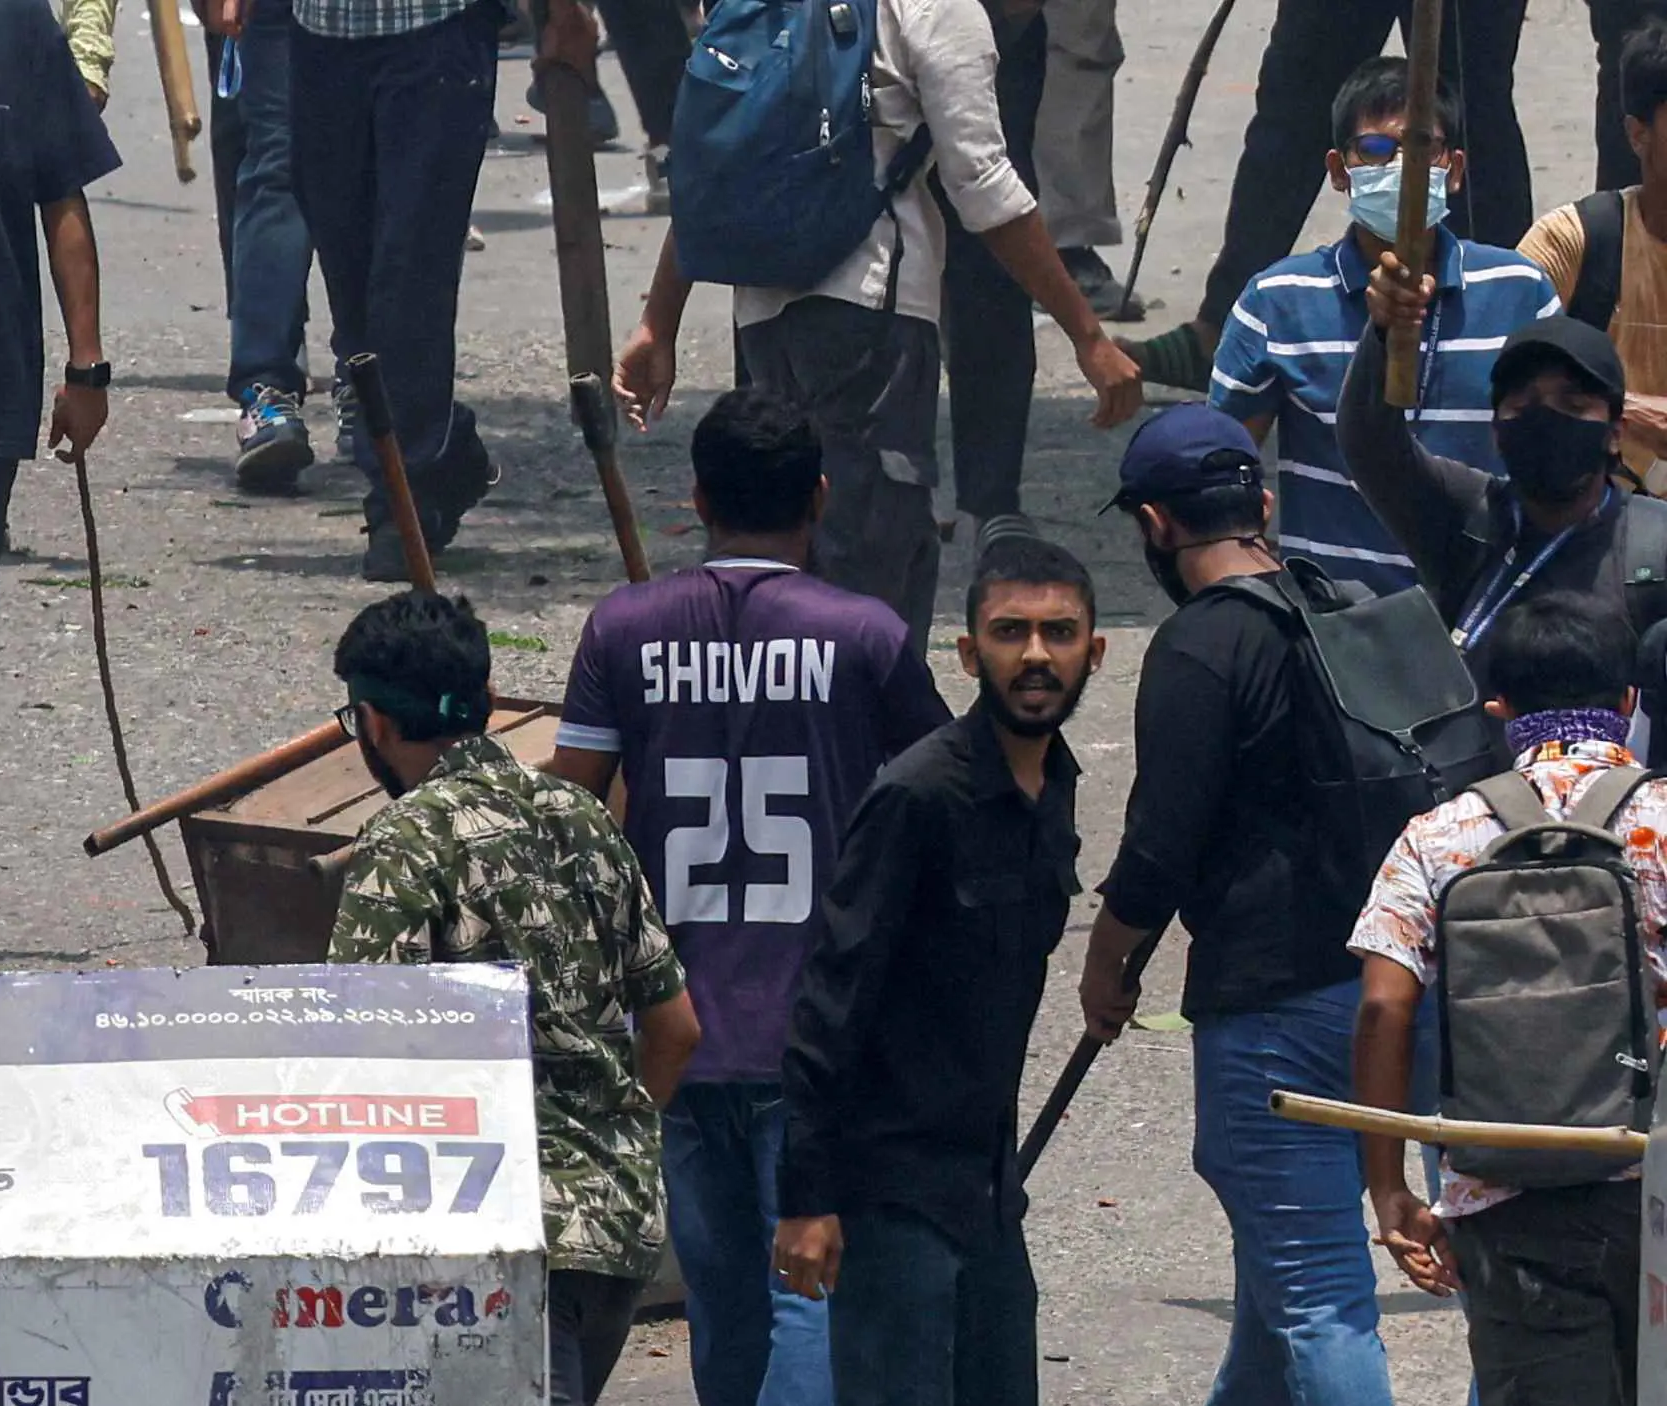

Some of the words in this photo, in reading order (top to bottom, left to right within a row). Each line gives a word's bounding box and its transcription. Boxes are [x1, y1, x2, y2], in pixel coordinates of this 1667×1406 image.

[641, 639, 835, 703] SHOVON
[664, 755, 813, 926] 25
[237, 1102, 448, 1129] HOTLINE
[142, 1140, 505, 1217] 16797
